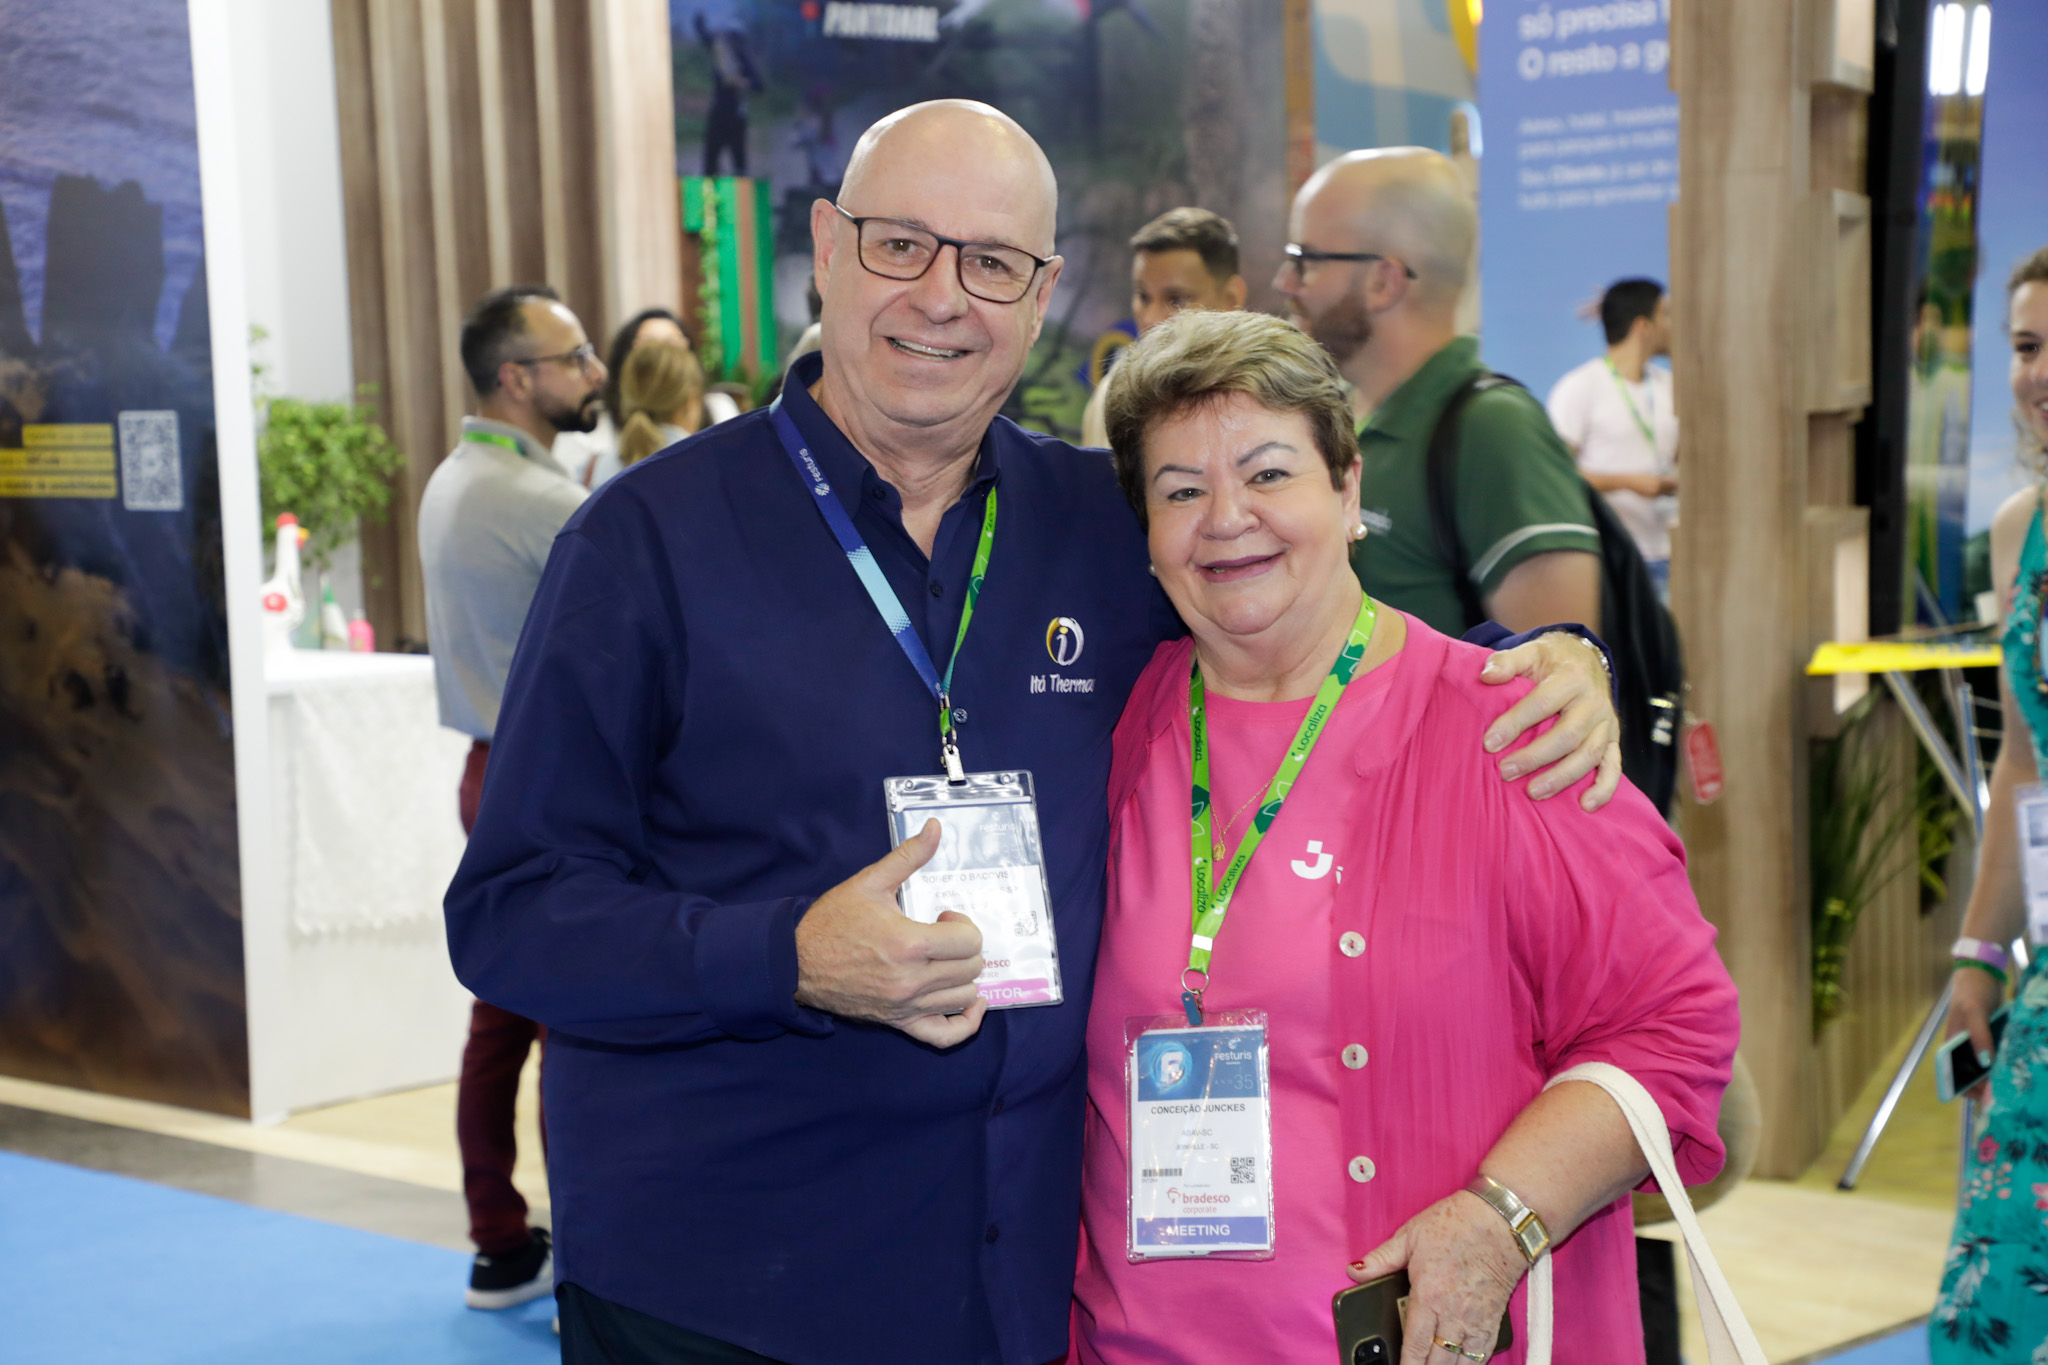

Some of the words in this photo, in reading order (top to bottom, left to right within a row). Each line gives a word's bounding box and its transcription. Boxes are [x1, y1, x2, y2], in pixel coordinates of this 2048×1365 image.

[1518, 3, 1554, 40] só
[1556, 1, 1657, 42] precisa
[1517, 47, 1545, 81] O
[1547, 43, 1617, 77] resto
[1620, 42, 1641, 70] a
[1297, 703, 1328, 751] Localiza
[1217, 855, 1246, 903] Localiza
[978, 987, 1023, 1000] SITOR
[1214, 1050, 1252, 1061] Festuris
[1151, 1103, 1201, 1115] CONCEIÇÃO
[1203, 1103, 1246, 1113] JUNCKES
[1183, 1193, 1231, 1204] bradesco
[1183, 1205, 1217, 1214] corporate
[1167, 1224, 1231, 1237] MEETING
